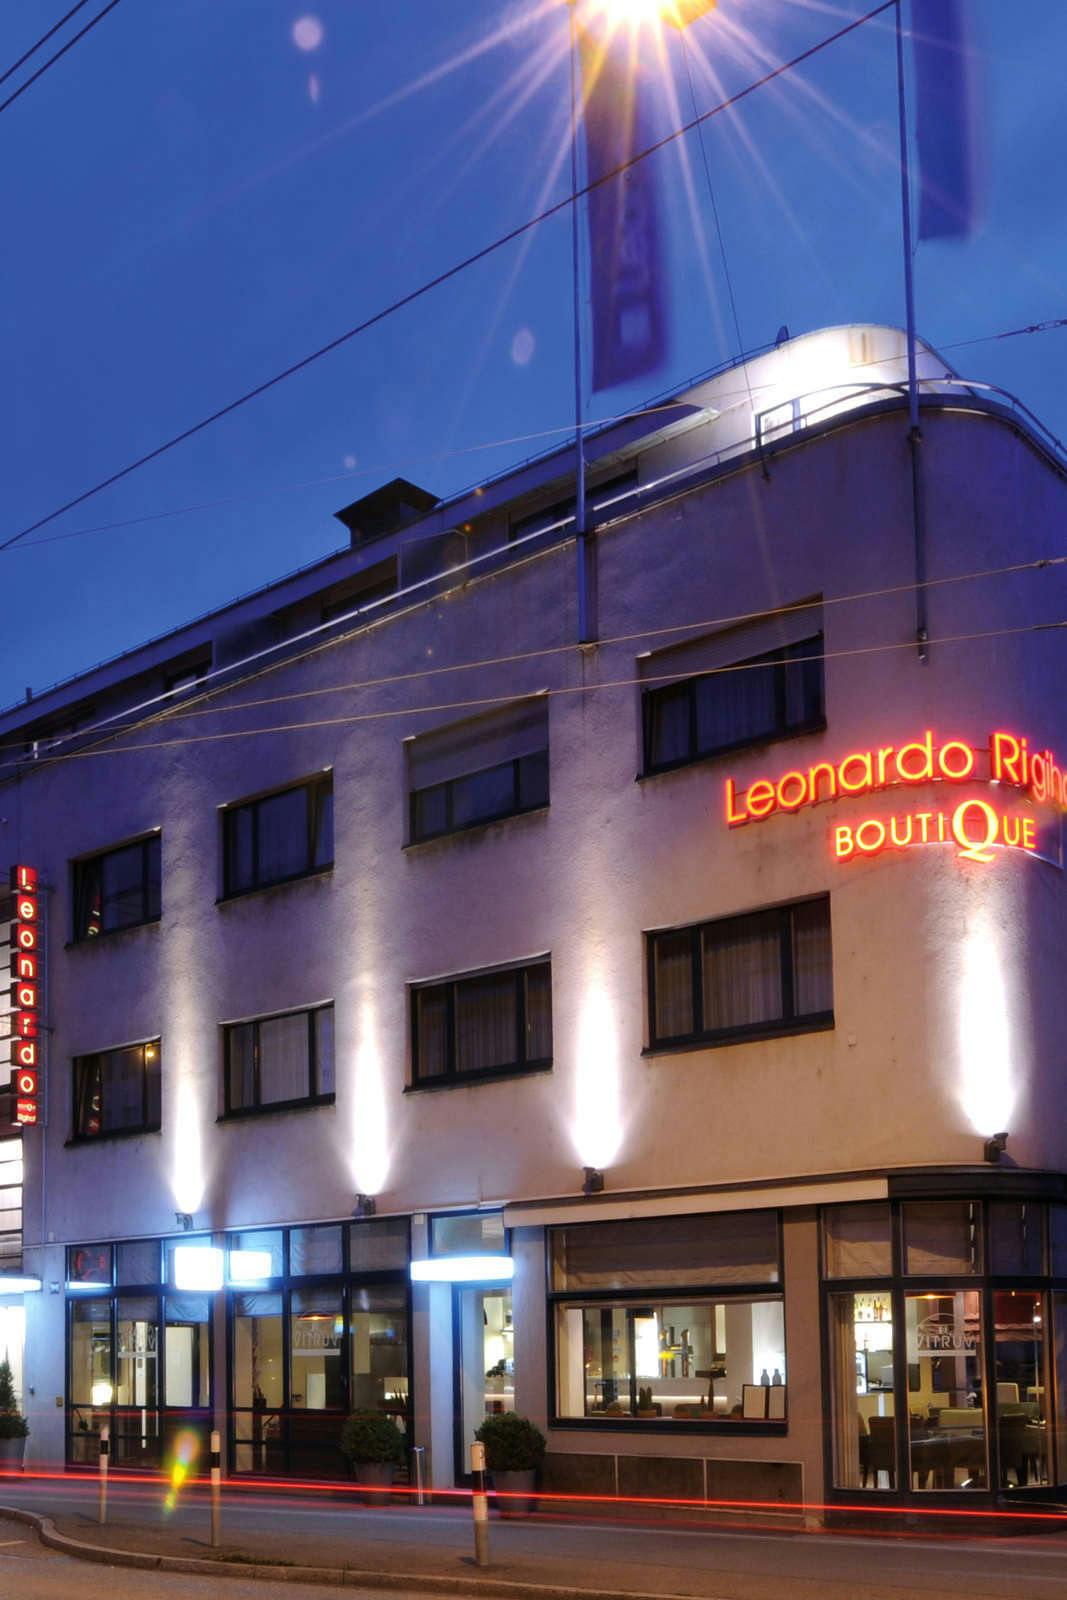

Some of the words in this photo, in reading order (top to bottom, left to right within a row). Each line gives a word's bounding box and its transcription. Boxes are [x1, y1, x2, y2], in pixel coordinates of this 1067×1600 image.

[725, 730, 974, 824] Leonardo
[834, 799, 1037, 863] BOUTIQUE
[19, 867, 35, 1094] Leonardo
